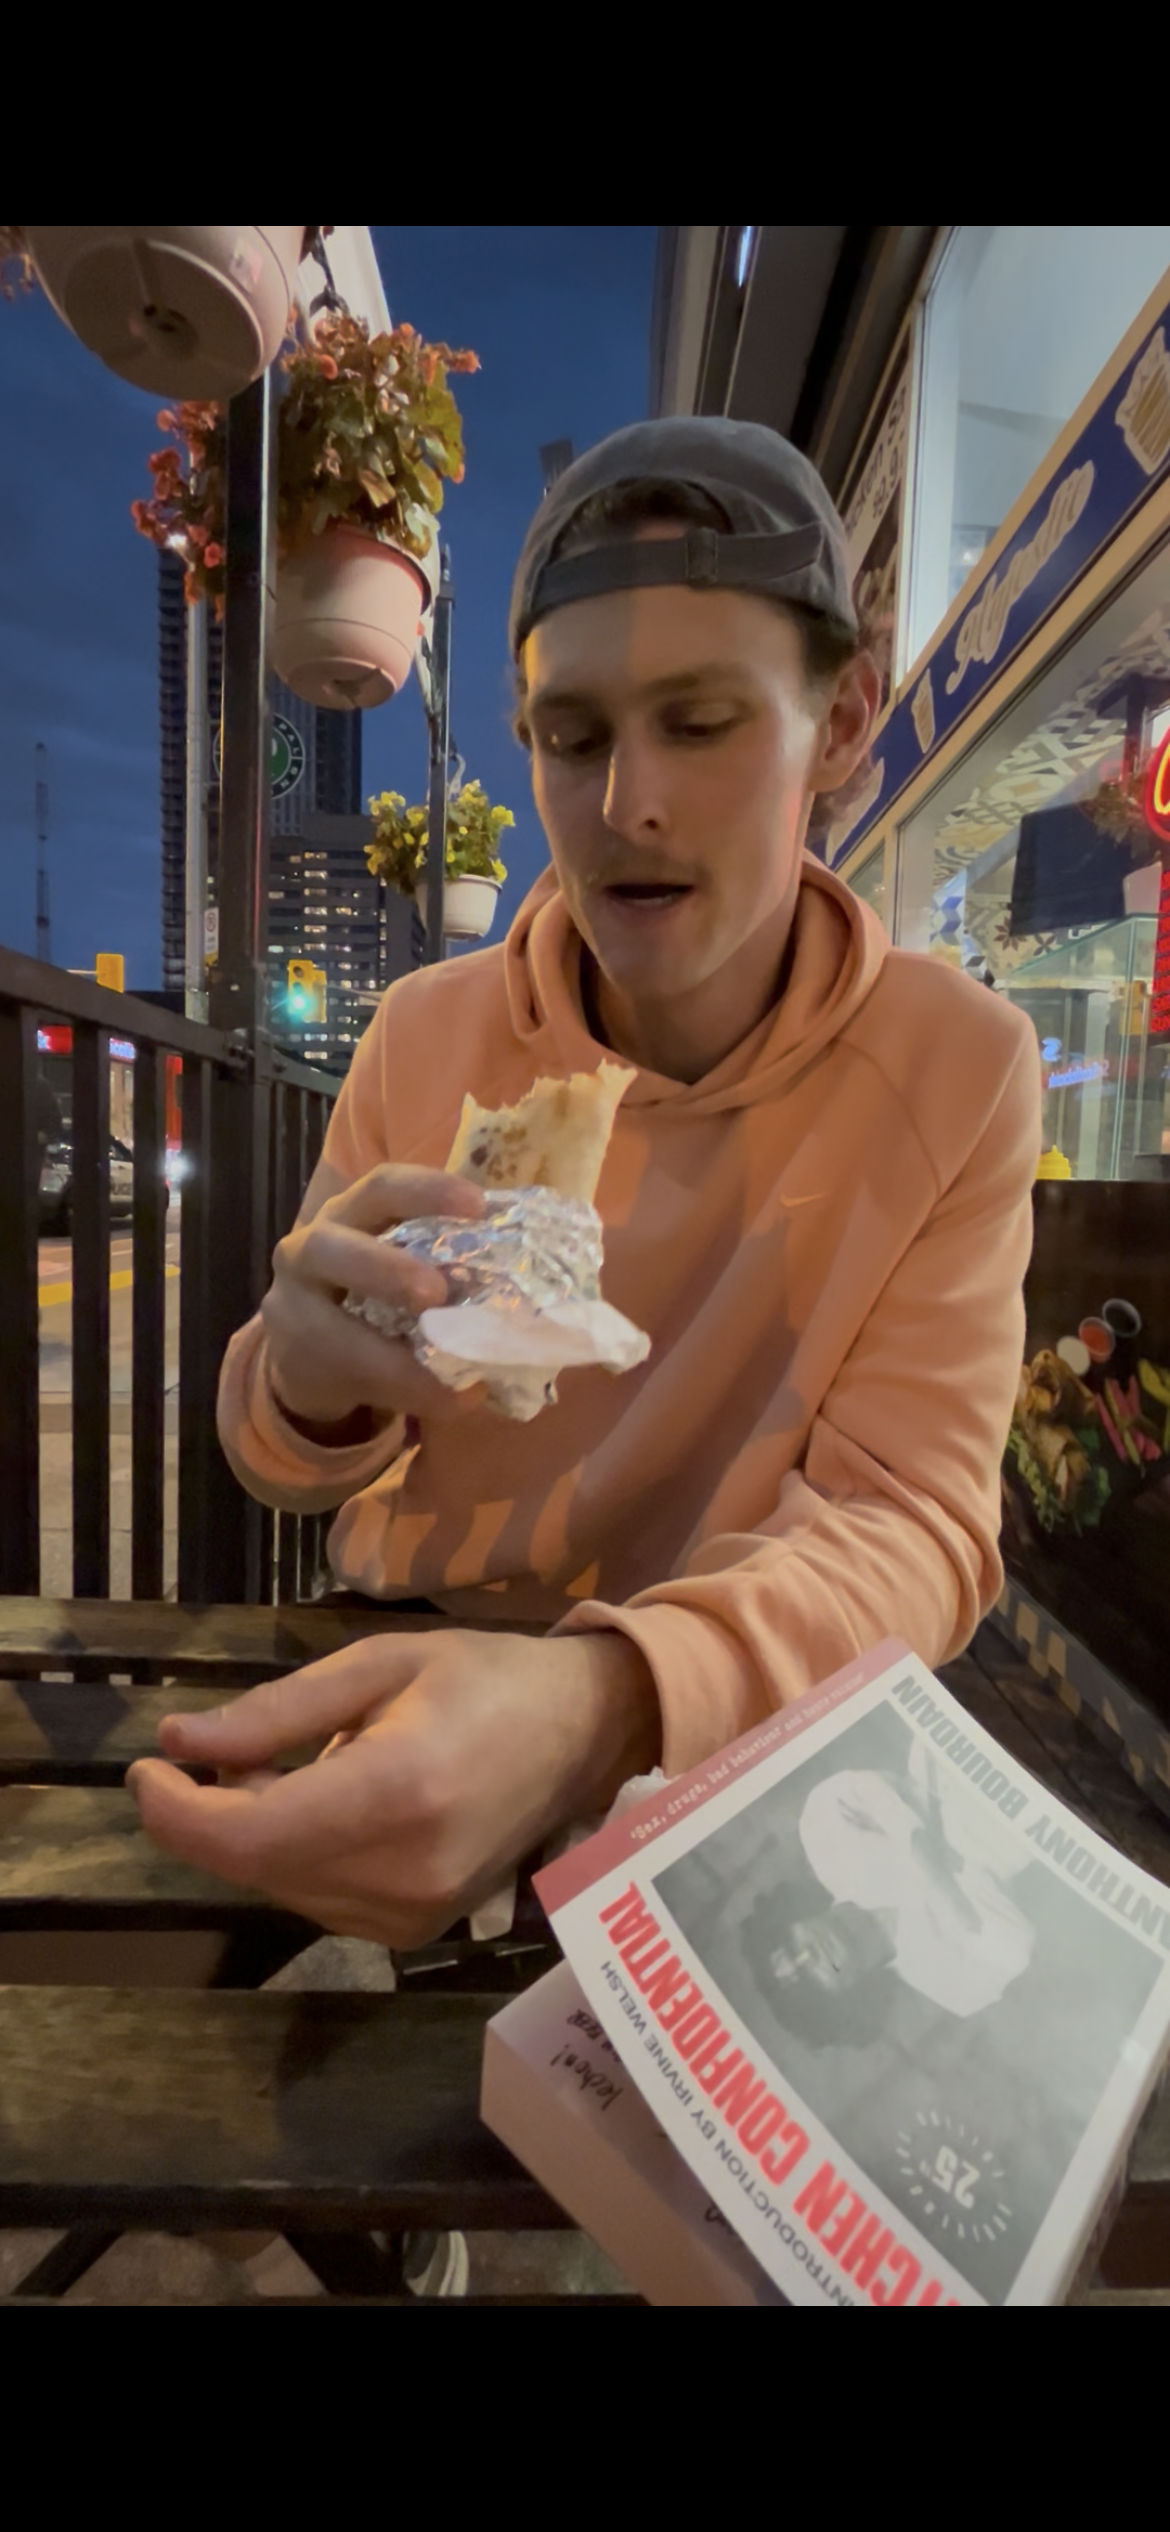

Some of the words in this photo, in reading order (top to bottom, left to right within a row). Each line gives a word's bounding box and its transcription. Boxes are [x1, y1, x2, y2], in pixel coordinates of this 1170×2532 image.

[706, 1764, 730, 1784] bad
[891, 1675, 1029, 1821] BOURDAIN
[598, 1881, 810, 2187] CONFIDENTIAL
[600, 1960, 647, 2035] WELSH
[645, 2033, 693, 2107] IRVINE
[691, 2108, 717, 2141] BY
[792, 2160, 962, 2306] TCHEN
